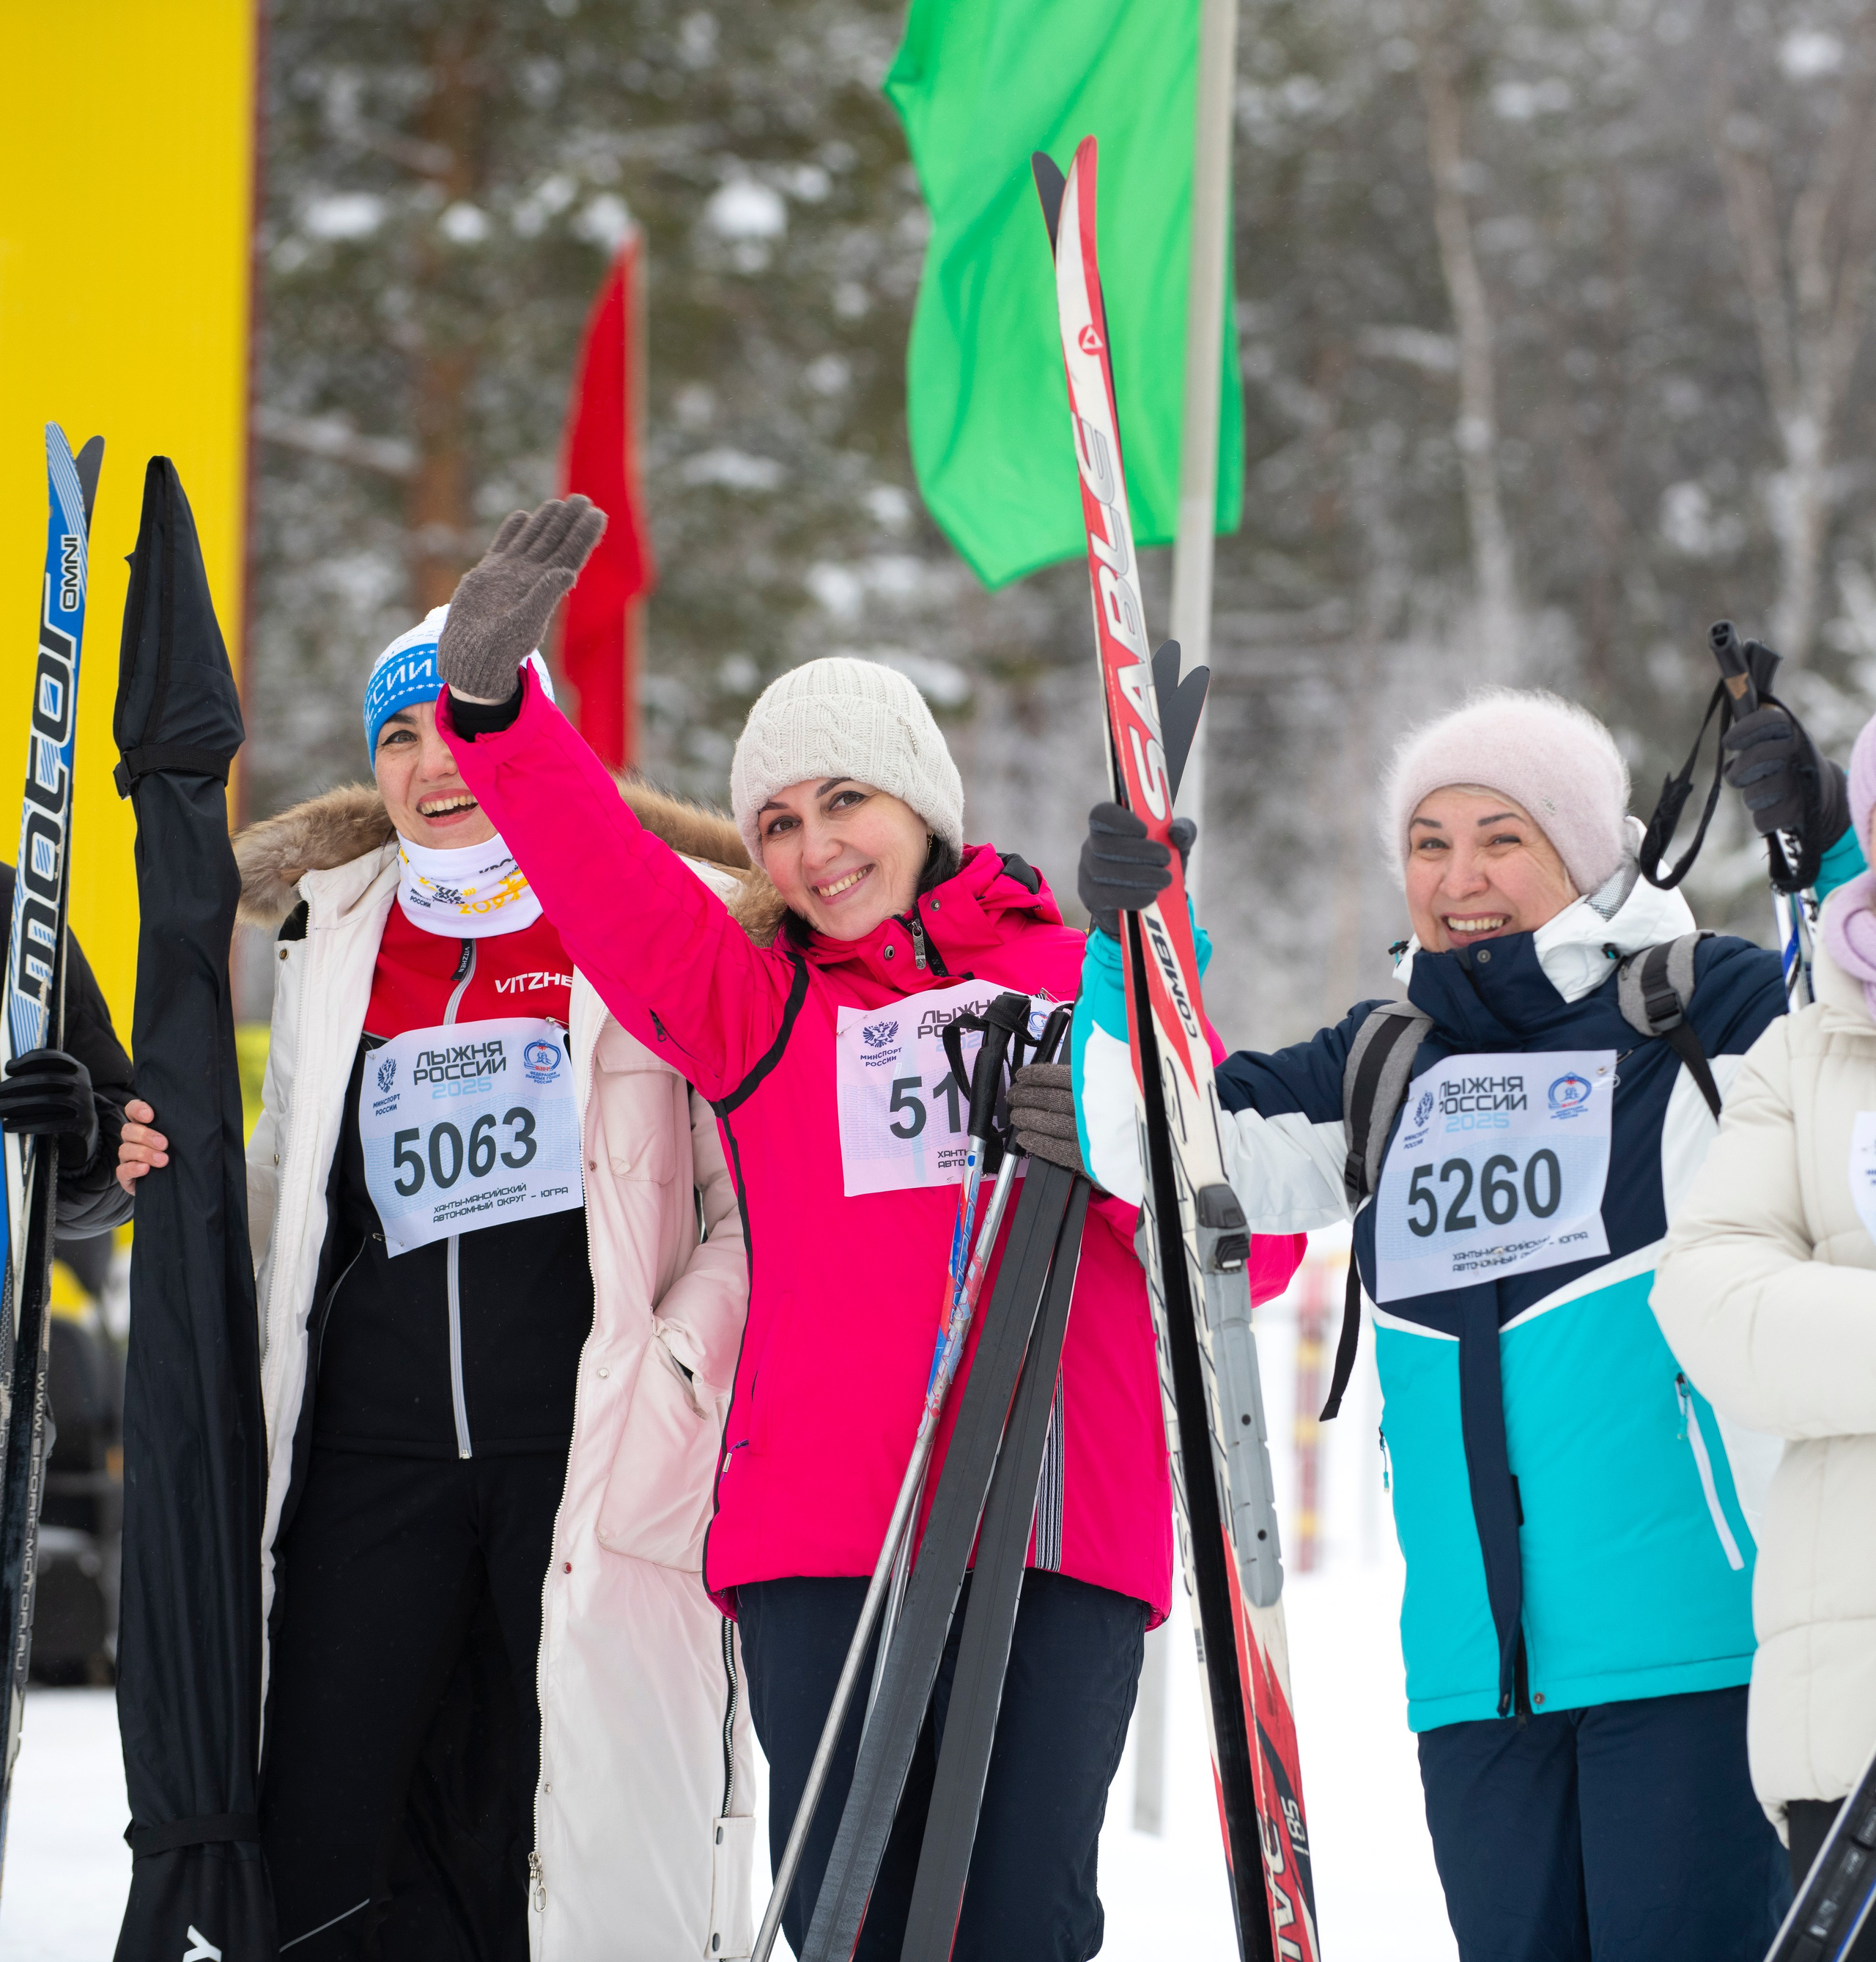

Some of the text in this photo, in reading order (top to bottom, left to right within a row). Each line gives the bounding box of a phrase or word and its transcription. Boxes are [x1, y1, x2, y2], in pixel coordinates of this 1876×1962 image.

[61, 534, 81, 612] OMNI
[1071, 409, 1166, 822] SABLE
[366, 658, 432, 733] ССИИ
[18, 572, 77, 998] motor
[410, 896, 431, 908] РОССИИ
[457, 946, 470, 973] VITZHEN
[495, 972, 573, 993] VITZHE
[1145, 914, 1197, 1039] COMBI
[921, 999, 995, 1024] ЛЫЖН
[416, 1040, 503, 1067] ЛЫЖНЯ
[860, 1047, 902, 1061] МИНСПОРТ
[865, 1055, 897, 1067] РОССИИ
[413, 1057, 506, 1085] РОССИИ
[373, 1094, 401, 1109] МИНСПОРТ
[432, 1077, 492, 1099] 2025
[375, 1104, 397, 1116] РОССИИ
[1445, 1113, 1510, 1133] 2025
[394, 1106, 537, 1197] 5063
[432, 1200, 493, 1223] АВТОНОМНЫЙ
[497, 1194, 527, 1209] ОКРУГ
[540, 1187, 569, 1198] ЮГРА
[433, 1183, 527, 1214] ХАНТЫ-МАНСИЙСКИЙ
[1408, 1148, 1562, 1237] 5260
[1281, 1796, 1310, 1856] 185
